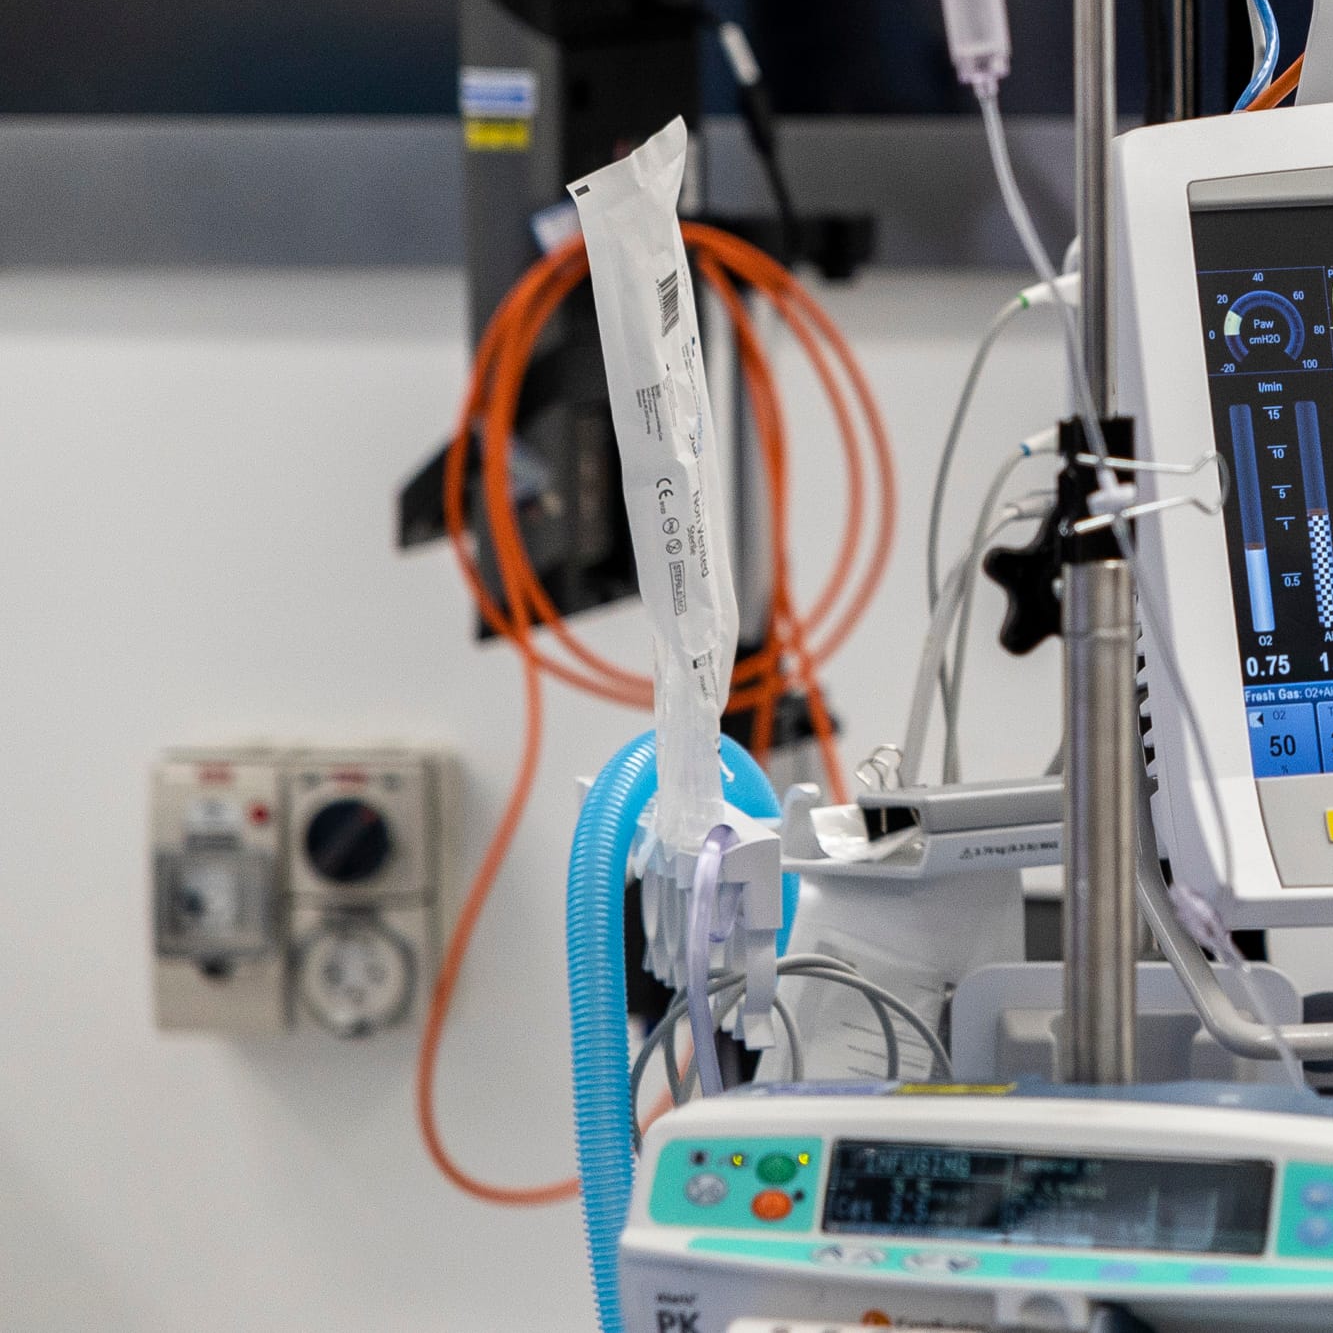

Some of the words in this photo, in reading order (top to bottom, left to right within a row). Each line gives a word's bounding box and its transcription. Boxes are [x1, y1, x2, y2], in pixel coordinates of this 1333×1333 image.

[1252, 273, 1264, 281] 40
[1217, 295, 1228, 303] 20
[1293, 291, 1304, 300] 60
[1254, 319, 1274, 328] Paw
[1314, 325, 1324, 334] 80
[1302, 360, 1318, 368] 100
[1268, 410, 1280, 419] 15
[1273, 449, 1284, 458] 10
[1246, 655, 1290, 677] 0.75
[1245, 690, 1276, 702] Fresh
[1270, 736, 1296, 756] 50
